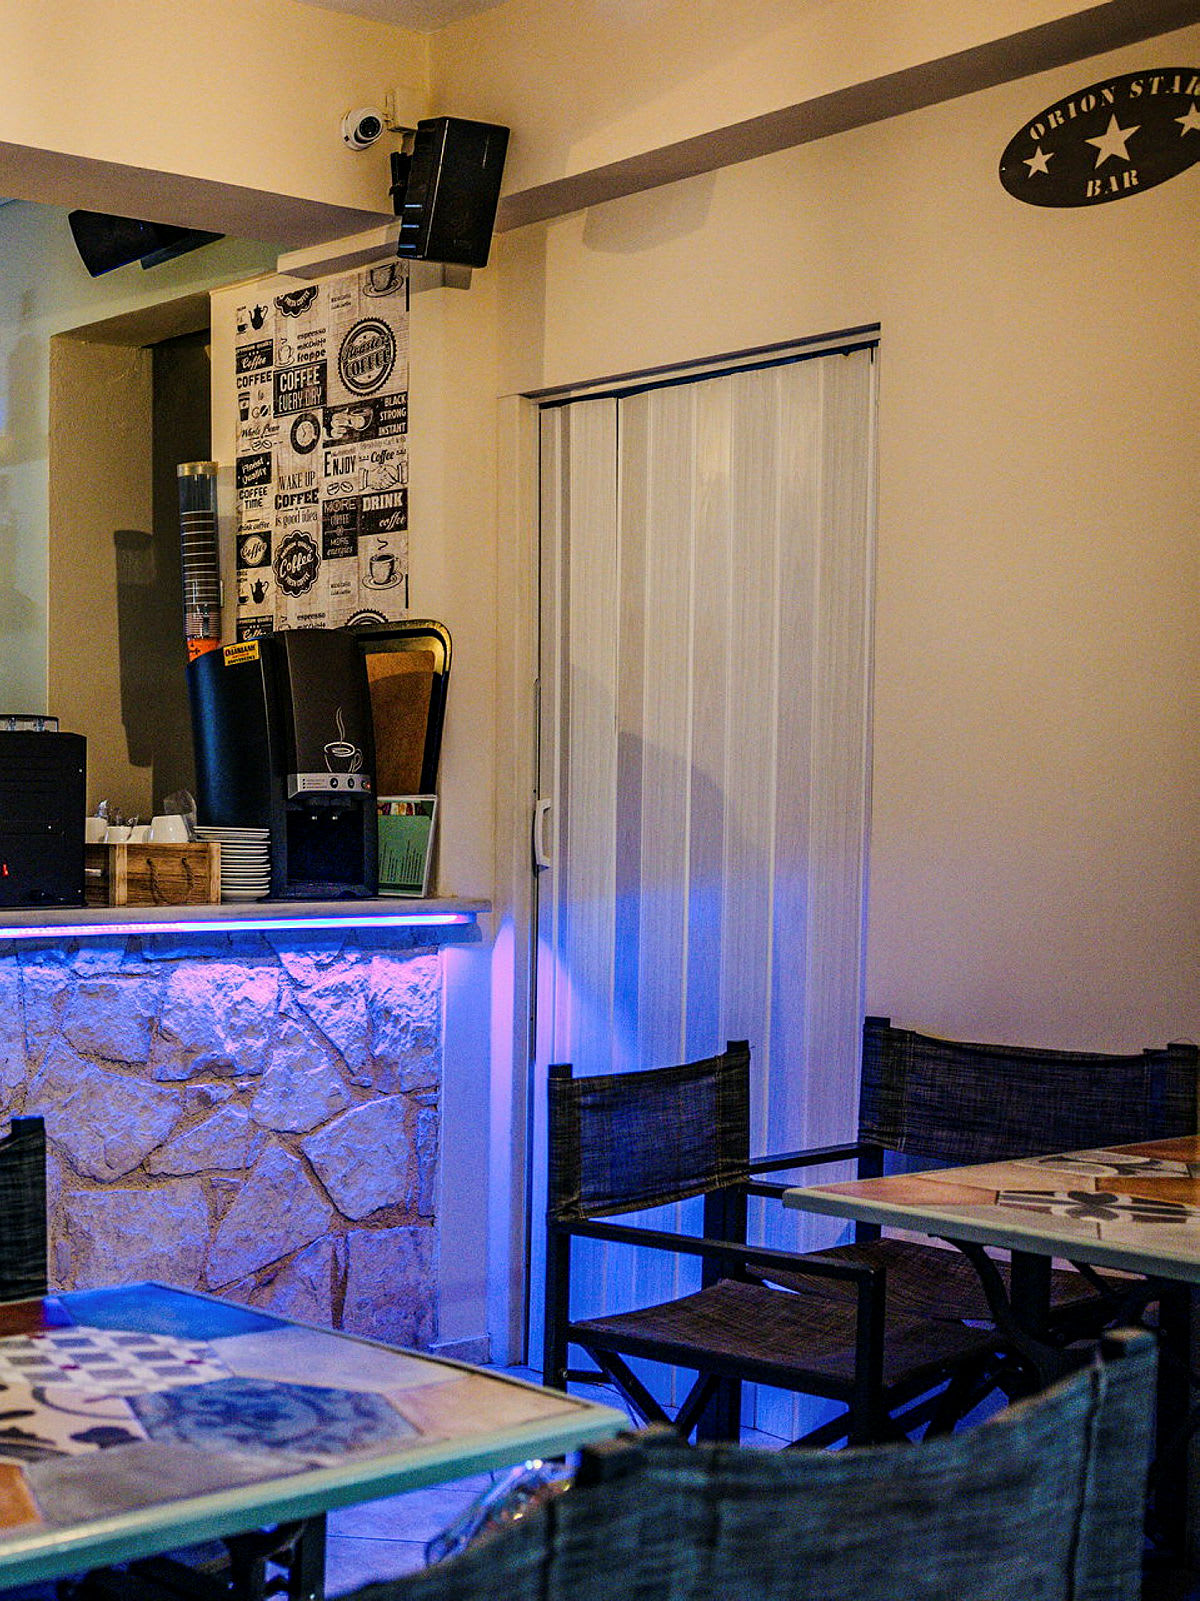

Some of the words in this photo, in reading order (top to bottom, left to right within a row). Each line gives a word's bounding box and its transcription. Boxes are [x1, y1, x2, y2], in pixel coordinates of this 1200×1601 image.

[1029, 85, 1115, 141] ORION
[1085, 169, 1140, 198] BAR
[236, 370, 273, 389] COFFEE
[279, 365, 321, 392] COFFEE
[384, 394, 407, 407] BLACK
[380, 408, 407, 421] STRONG
[323, 450, 357, 478] ENJOY
[370, 448, 394, 464] Coffee
[279, 472, 303, 491] WAKE
[305, 471, 316, 487] UP
[238, 486, 268, 500] COFFEE
[274, 487, 319, 510] COFFEE
[362, 491, 403, 512] DRINK
[244, 498, 263, 509] TIME
[324, 497, 357, 513] MORE
[379, 511, 407, 530] coffee
[279, 552, 314, 578] Coffee
